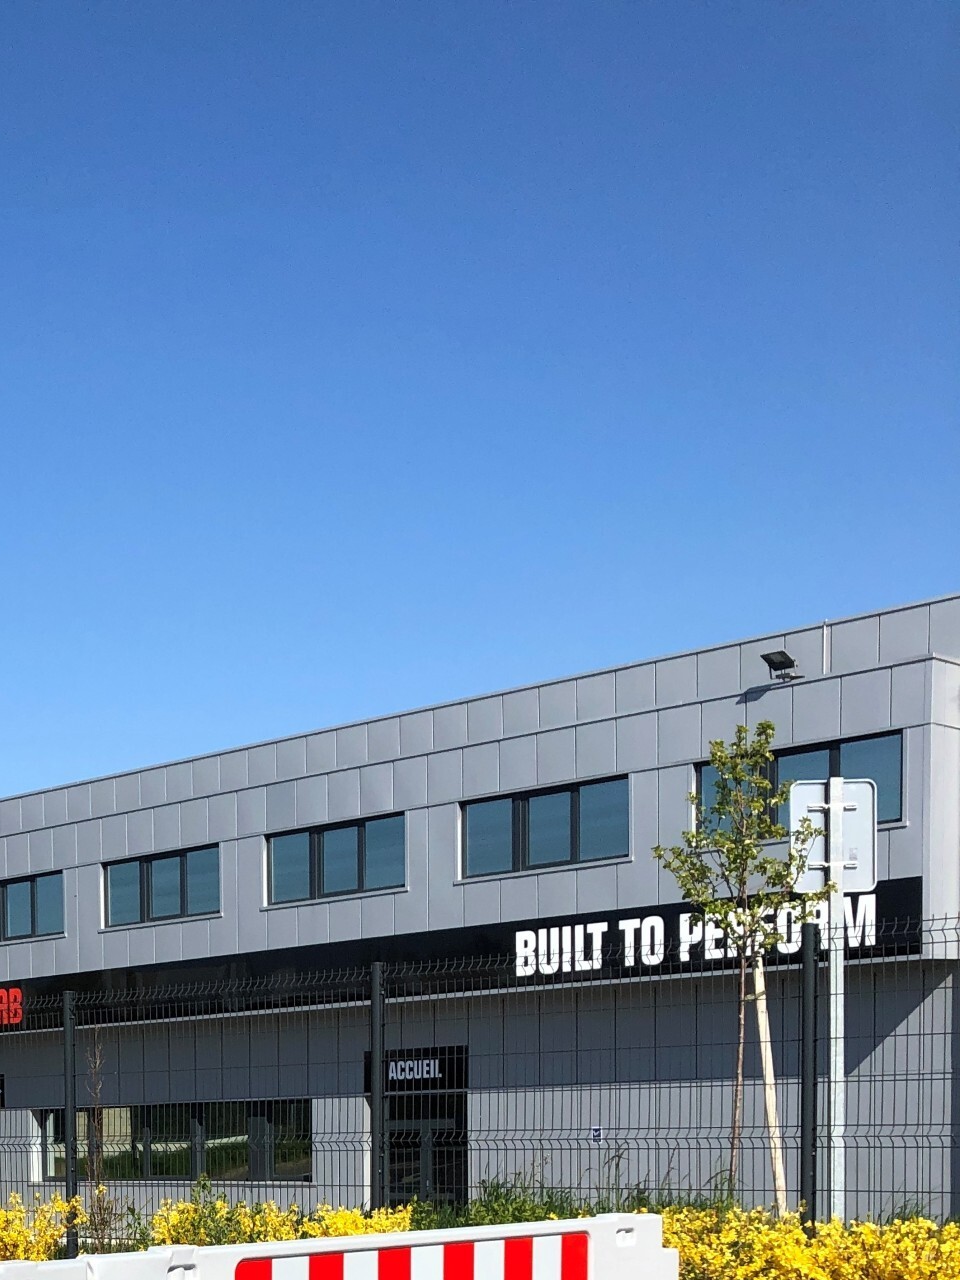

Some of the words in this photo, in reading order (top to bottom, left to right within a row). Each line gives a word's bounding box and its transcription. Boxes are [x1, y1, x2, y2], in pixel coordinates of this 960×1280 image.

[515, 921, 608, 977] BUILT
[618, 915, 665, 967] TO
[388, 1059, 443, 1080] ACCUEIL
